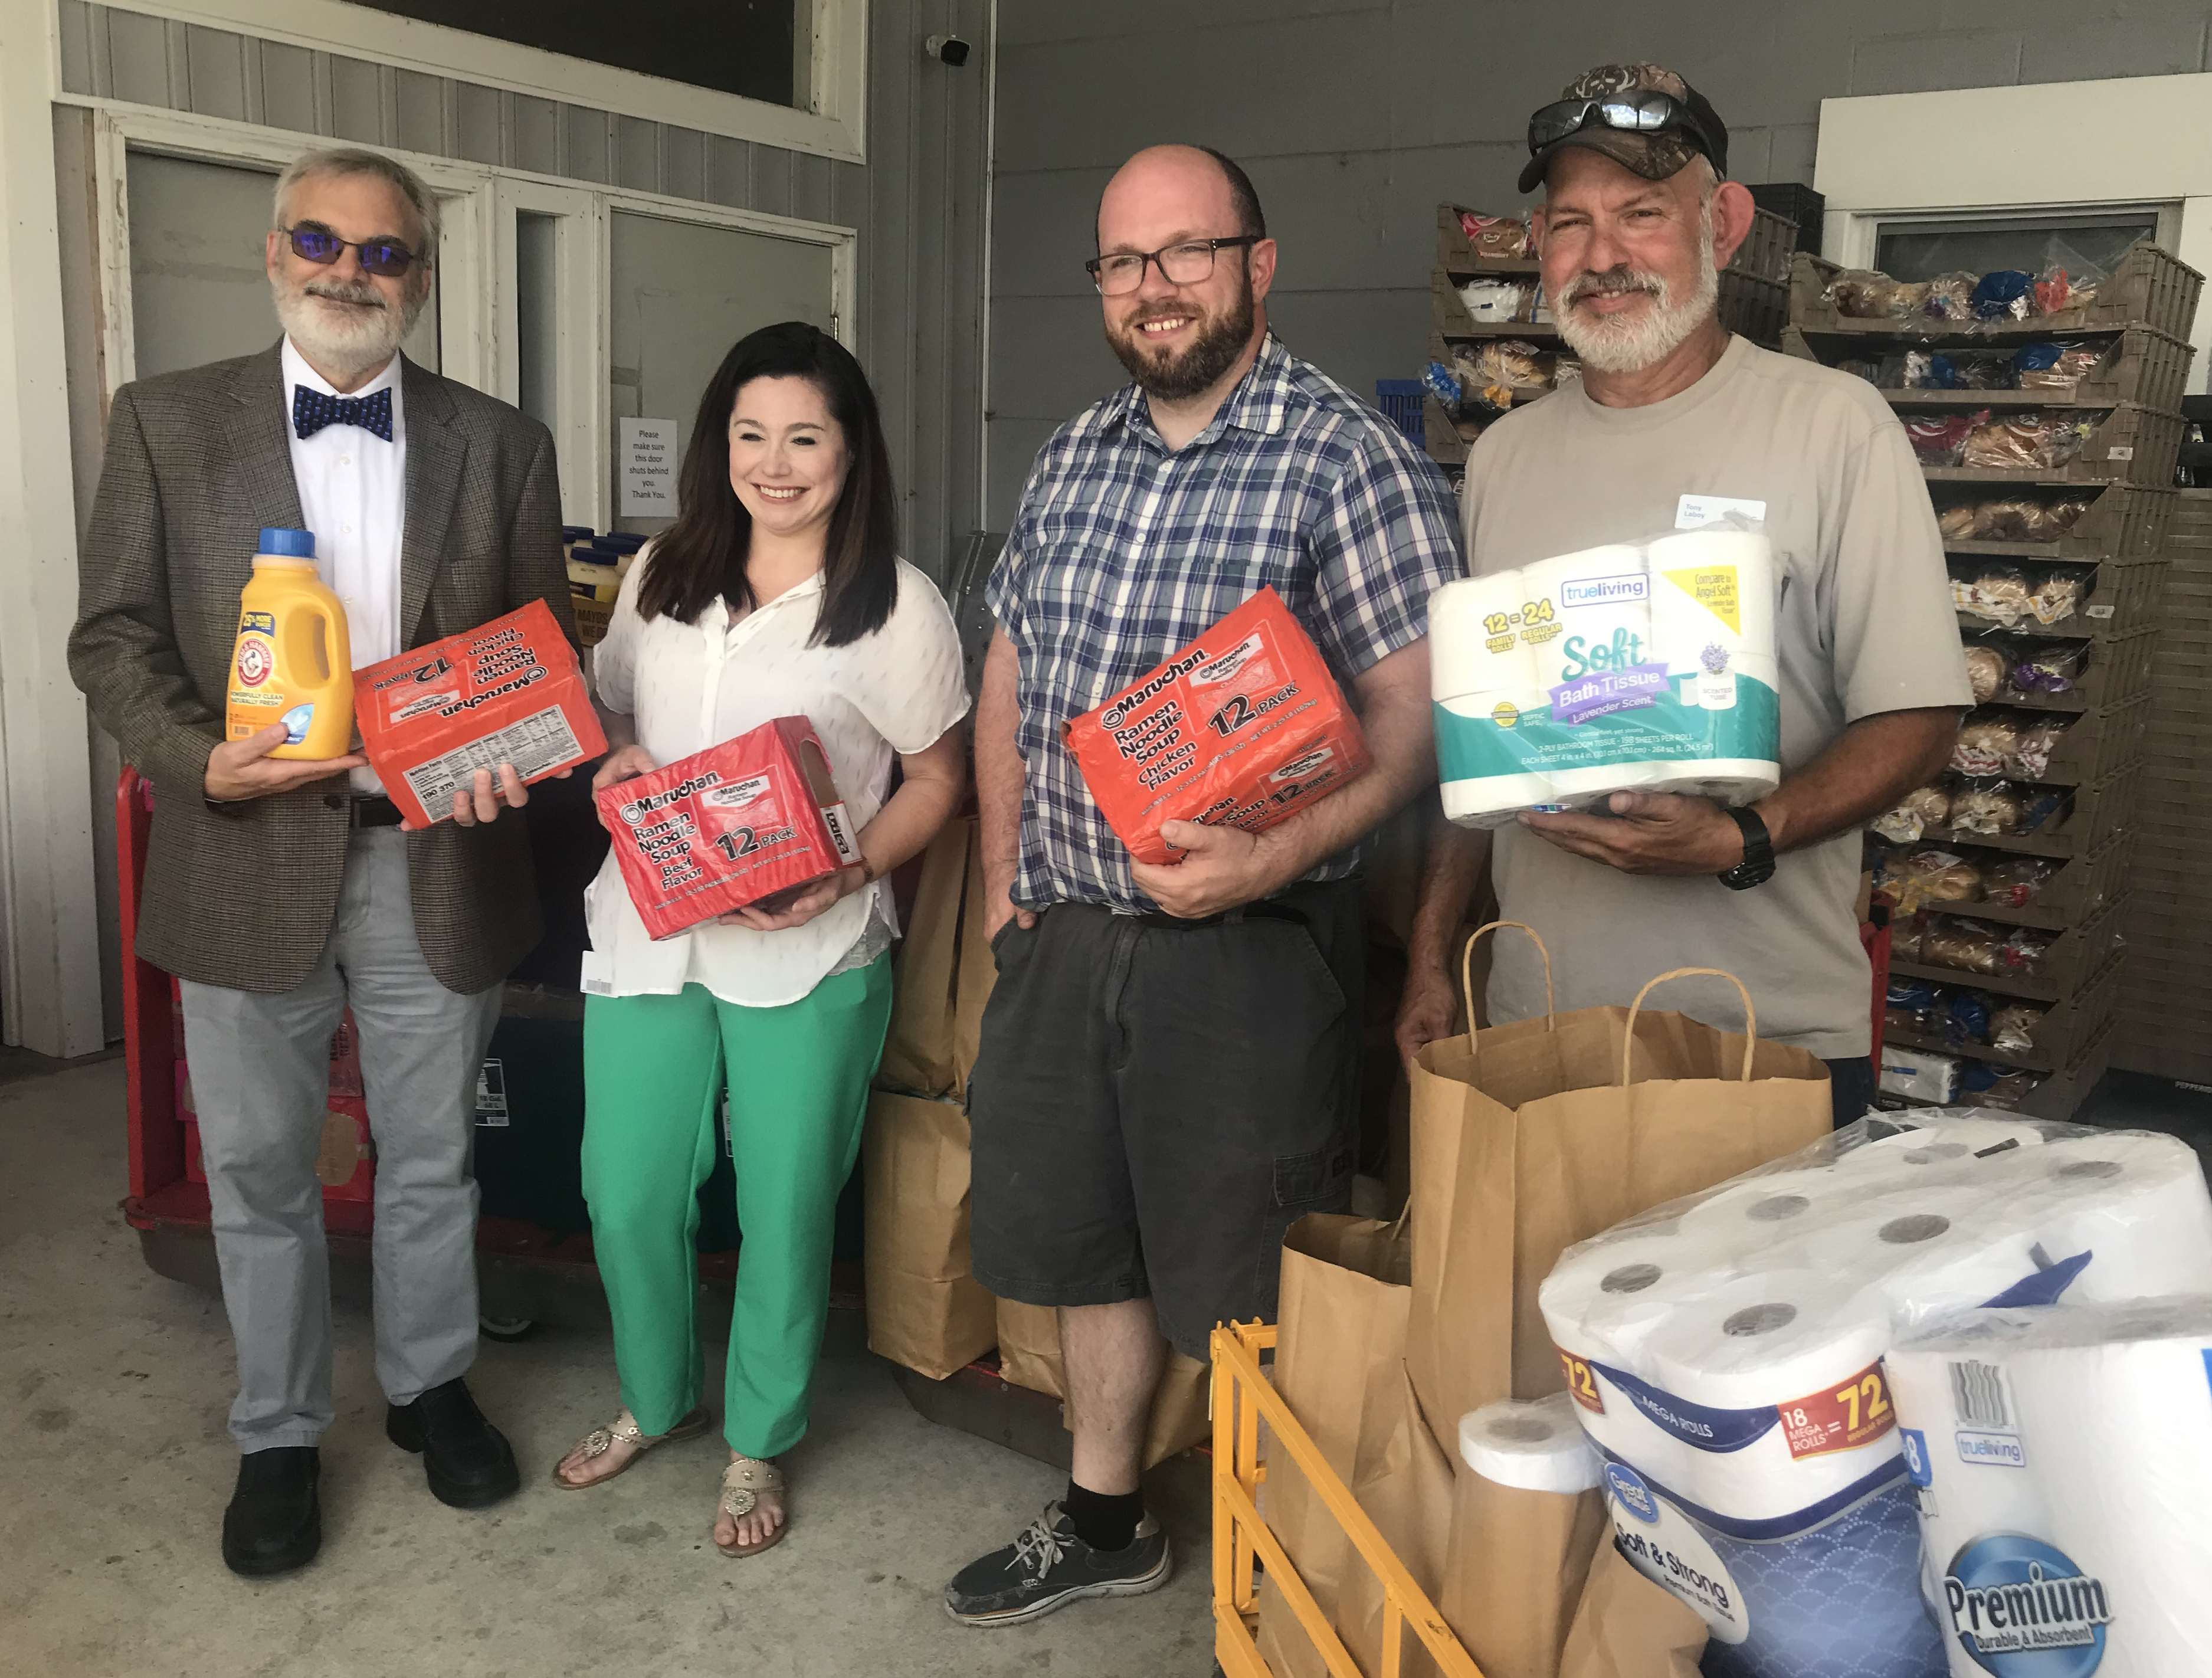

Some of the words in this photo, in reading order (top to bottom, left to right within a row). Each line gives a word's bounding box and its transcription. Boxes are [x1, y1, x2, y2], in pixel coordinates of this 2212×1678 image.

[639, 430, 659, 438] Please
[630, 466, 645, 474] shuts
[648, 466, 668, 474] behind
[1567, 581, 1643, 600] trueliving
[1695, 573, 1725, 585] Compare
[1696, 585, 1716, 598] Angel
[1483, 612, 1509, 635] 12
[1522, 598, 1555, 626] 24
[467, 631, 525, 656] Chicken
[471, 628, 516, 648] Flavor
[1486, 633, 1516, 648] FAMILY
[1520, 622, 1562, 640] REGULAR
[1491, 643, 1513, 654] ROLLS
[473, 647, 535, 677] Noodle
[477, 644, 523, 665] Soup
[1209, 641, 1251, 671] Maruchan
[1562, 627, 1646, 681] Soft
[372, 671, 412, 690] PACK
[414, 657, 454, 684] 12
[477, 656, 537, 684] Ramen
[1118, 649, 1206, 713] Maruchan
[441, 675, 531, 717] Maruchan
[1559, 681, 1599, 707] Bath
[1601, 672, 1660, 693] Tissue
[1114, 700, 1177, 744] Ramen
[1208, 694, 1259, 739] 12
[1257, 680, 1302, 715] PACK
[1522, 713, 1545, 721] SEPTIC
[1573, 703, 1620, 723] Lavender
[1622, 695, 1652, 708] Scent
[1119, 712, 1183, 758] Noodle
[1249, 731, 1262, 742] NET
[1284, 710, 1293, 719] LB
[1135, 728, 1181, 765] Soup
[1538, 744, 1555, 753] 2-PLY
[1557, 740, 1592, 751] BATHROOM
[1594, 738, 1616, 746] TISSUE
[1621, 735, 1634, 744] 198
[1636, 735, 1660, 743] SHEETS
[1675, 733, 1694, 741] ROLL
[1138, 741, 1197, 785] Chicken
[1286, 753, 1323, 774] Maruchan
[1541, 754, 1560, 763] SHEET
[1149, 756, 1195, 791] Flavor
[422, 788, 438, 800] 190
[440, 781, 454, 793] 370
[637, 771, 720, 811] Maruchan
[720, 779, 761, 796] Maruchan
[1270, 782, 1305, 805] 12
[1304, 770, 1337, 792] PACK
[1228, 799, 1267, 822] Soup
[1240, 810, 1270, 829] lavor
[633, 812, 690, 840] Ramen
[638, 824, 695, 852] Noodle
[651, 841, 692, 864] Soup
[715, 825, 761, 861] 12
[761, 827, 799, 848] PACK
[661, 867, 703, 890] Flavor
[662, 857, 693, 877] Beef
[1561, 1353, 1597, 1399] 72
[1643, 1395, 1679, 1427] MEGA
[1679, 1417, 1714, 1437] ROLLS
[1836, 1374, 1888, 1431] 72
[1783, 1408, 1808, 1430] 18
[1788, 1423, 1822, 1440] MEGA
[1957, 1438, 2021, 1461] trueliving
[1610, 1471, 1649, 1504] Great
[1616, 1522, 1649, 1558] Soft
[1650, 1542, 1666, 1568] &
[1666, 1551, 1729, 1609] Strong
[1944, 1562, 2109, 1633] Premium
[1975, 1631, 2020, 1650] Durable
[2021, 1629, 2031, 1646] &
[2031, 1624, 2093, 1645] Absorbent
